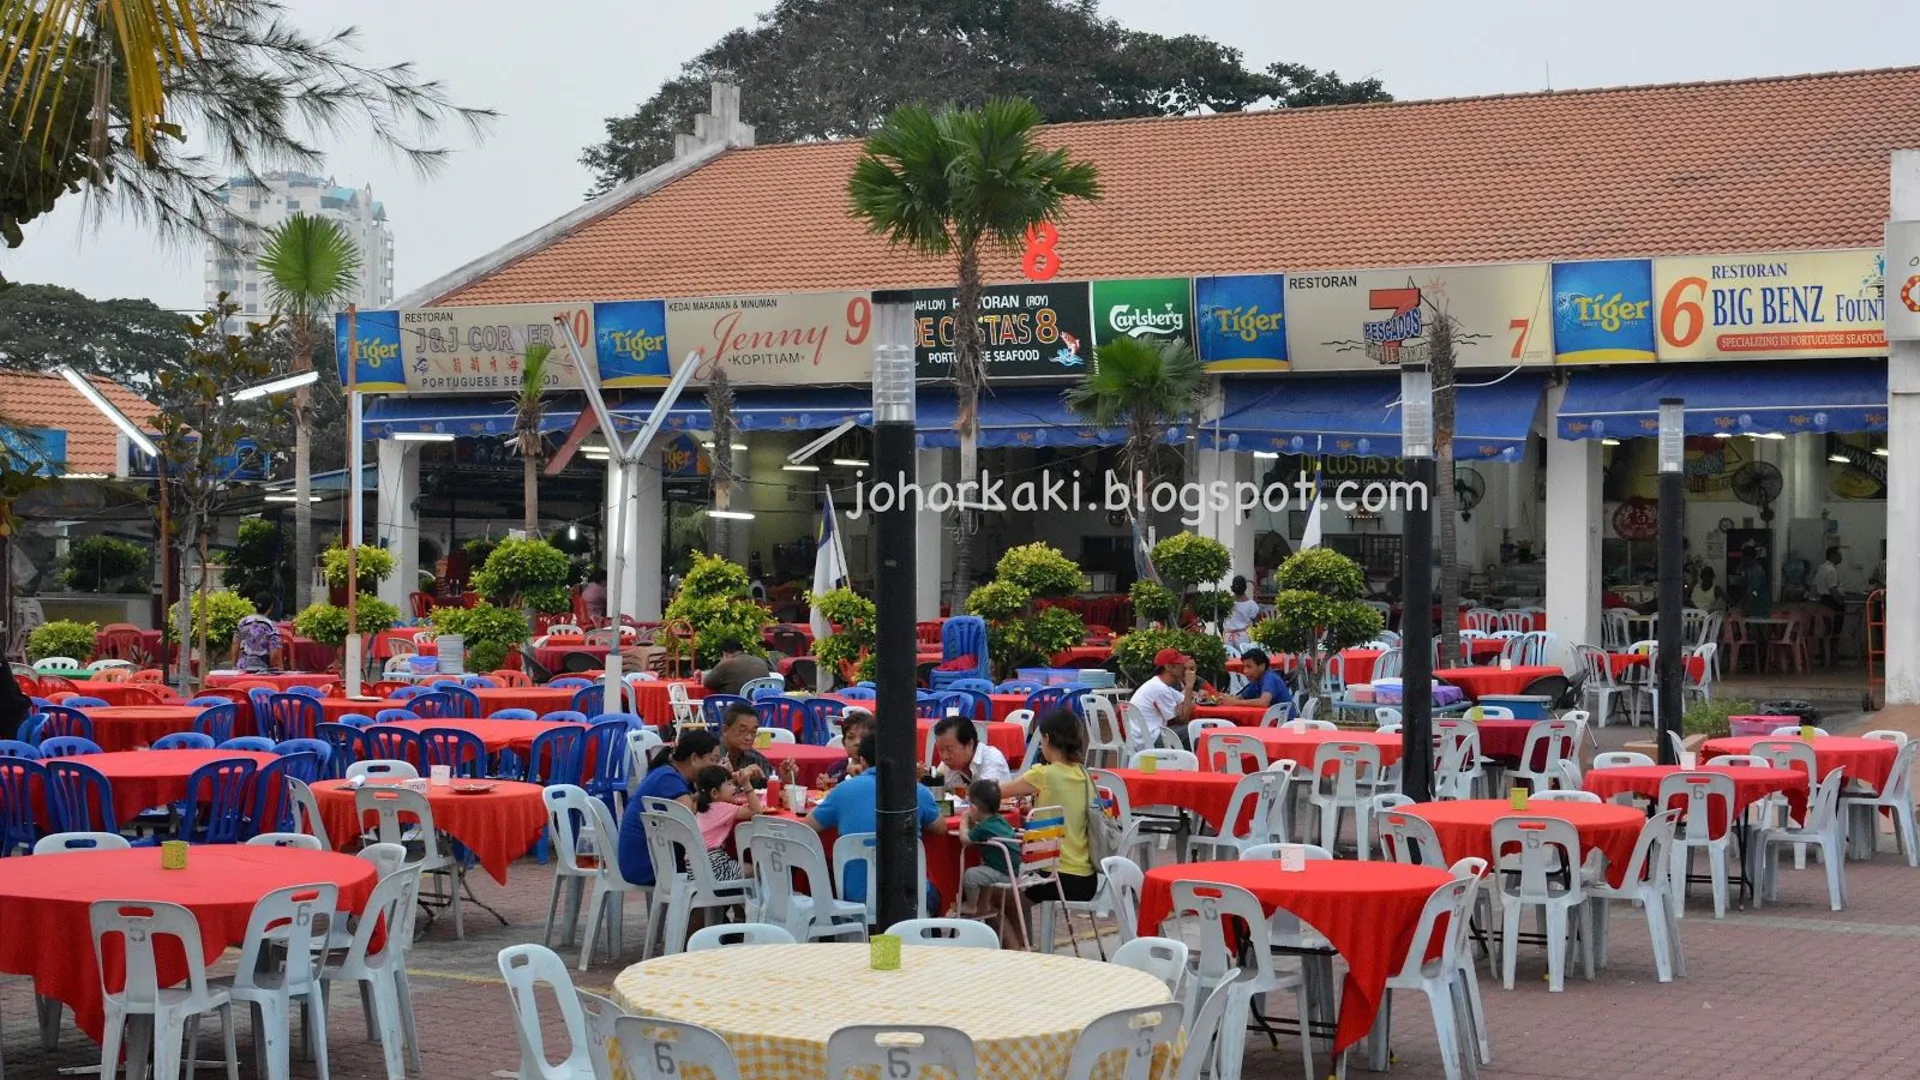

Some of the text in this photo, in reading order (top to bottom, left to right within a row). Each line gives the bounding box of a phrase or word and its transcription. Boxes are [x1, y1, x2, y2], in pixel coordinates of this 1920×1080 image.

[1022, 219, 1061, 280] 8
[1290, 276, 1357, 289] RESTORAN
[1712, 263, 1788, 279] RESTORAN
[405, 312, 454, 323] RESTORAN
[668, 298, 778, 312] KEDAI MAKANAN & MINUMAN
[953, 295, 1019, 310] RTORAN
[1026, 294, 1049, 307] (ROY)
[1574, 292, 1650, 332] Tiger
[1661, 276, 1707, 348] 6
[1712, 287, 1753, 326] BIG
[1761, 285, 1824, 324] BENZ
[845, 296, 872, 346] 9
[1035, 308, 1058, 344] 8
[1109, 303, 1184, 334] Carlsberg
[1215, 305, 1283, 342] Tiger
[1365, 307, 1421, 340] PESCADOS
[1369, 288, 1421, 364] 7
[416, 327, 459, 353] J&J
[611, 327, 666, 361] Tiger
[695, 311, 829, 381] Jenny
[1510, 318, 1529, 358] 7
[1721, 332, 1886, 348] SPECIALIZING IN PORTUGUESE SEAFOOD
[733, 353, 801, 365] KOPITIAM
[994, 349, 1040, 362] SEAFOOD
[422, 375, 499, 388] PORTUGUESE
[297, 902, 311, 927] 6
[1202, 897, 1218, 921] 6
[654, 1041, 676, 1075] 6
[887, 1047, 911, 1079] 6
